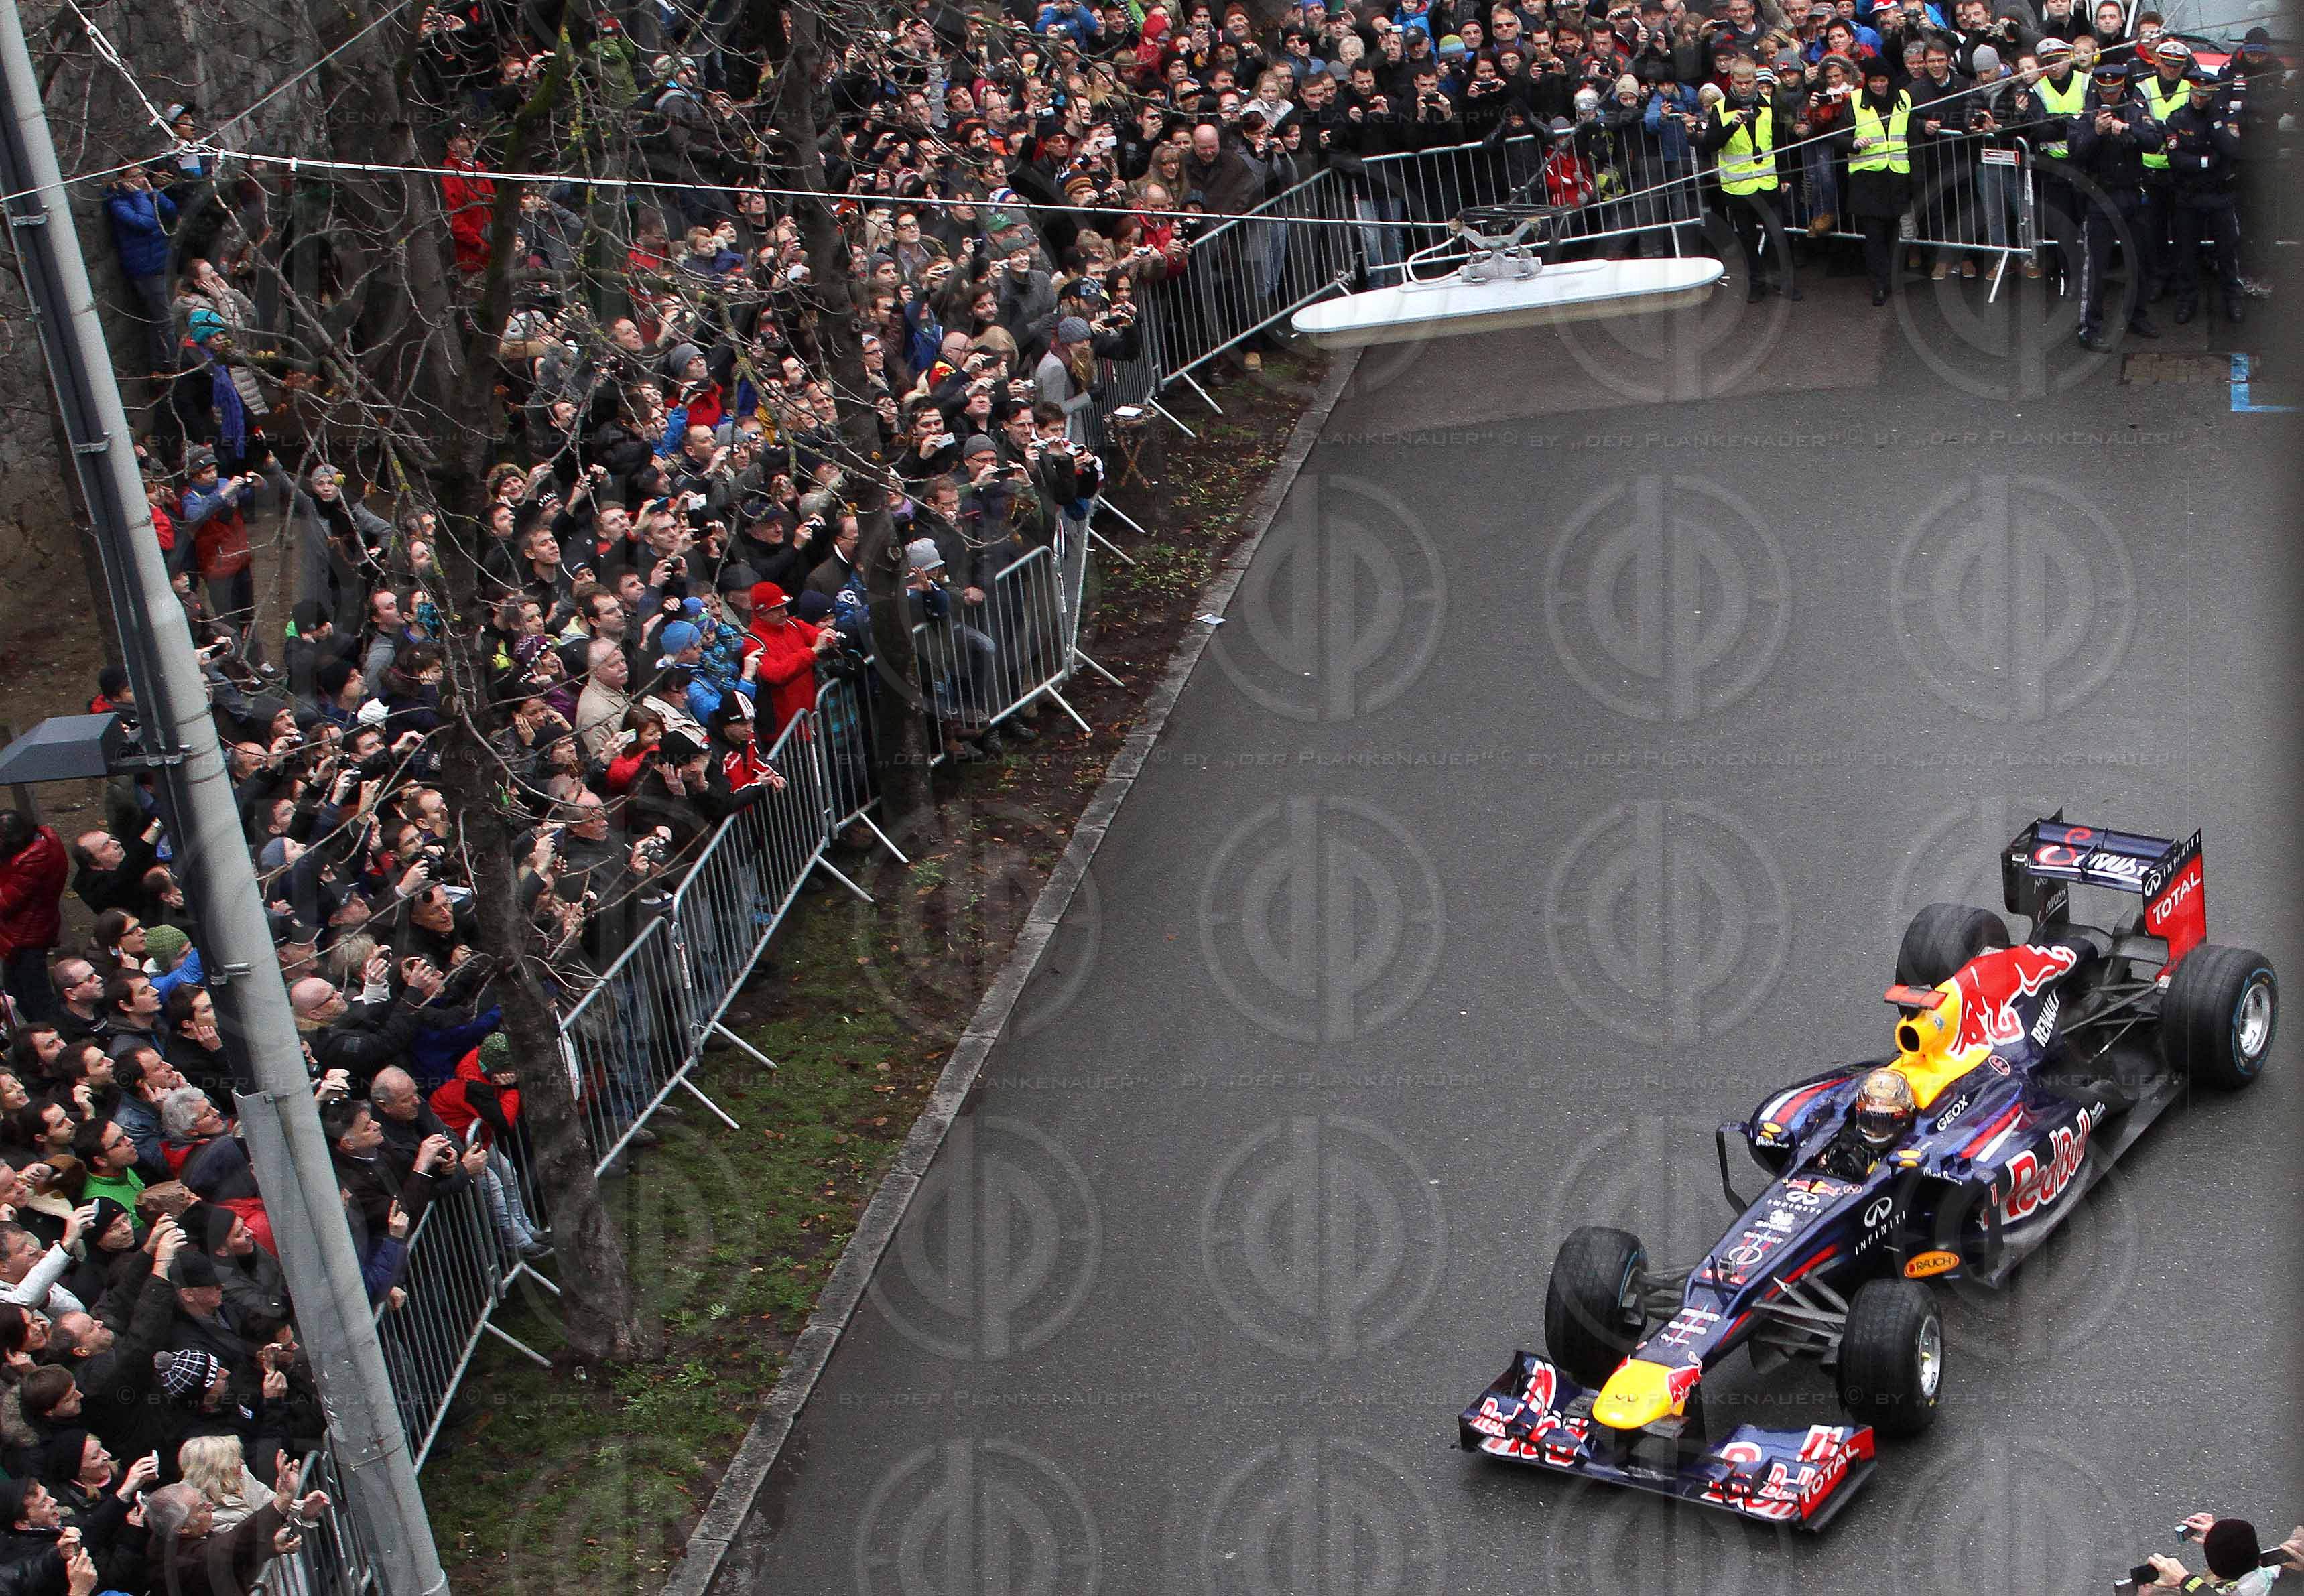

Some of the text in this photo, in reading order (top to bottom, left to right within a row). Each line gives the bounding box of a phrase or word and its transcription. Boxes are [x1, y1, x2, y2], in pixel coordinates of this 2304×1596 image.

[2152, 872, 2201, 925] TOTAL
[2031, 988, 2061, 1047] RENAULT
[1937, 1094, 1968, 1132] GEOX
[1854, 1210, 1906, 1256] INFINITI
[1799, 1443, 1860, 1503] TOTAL
